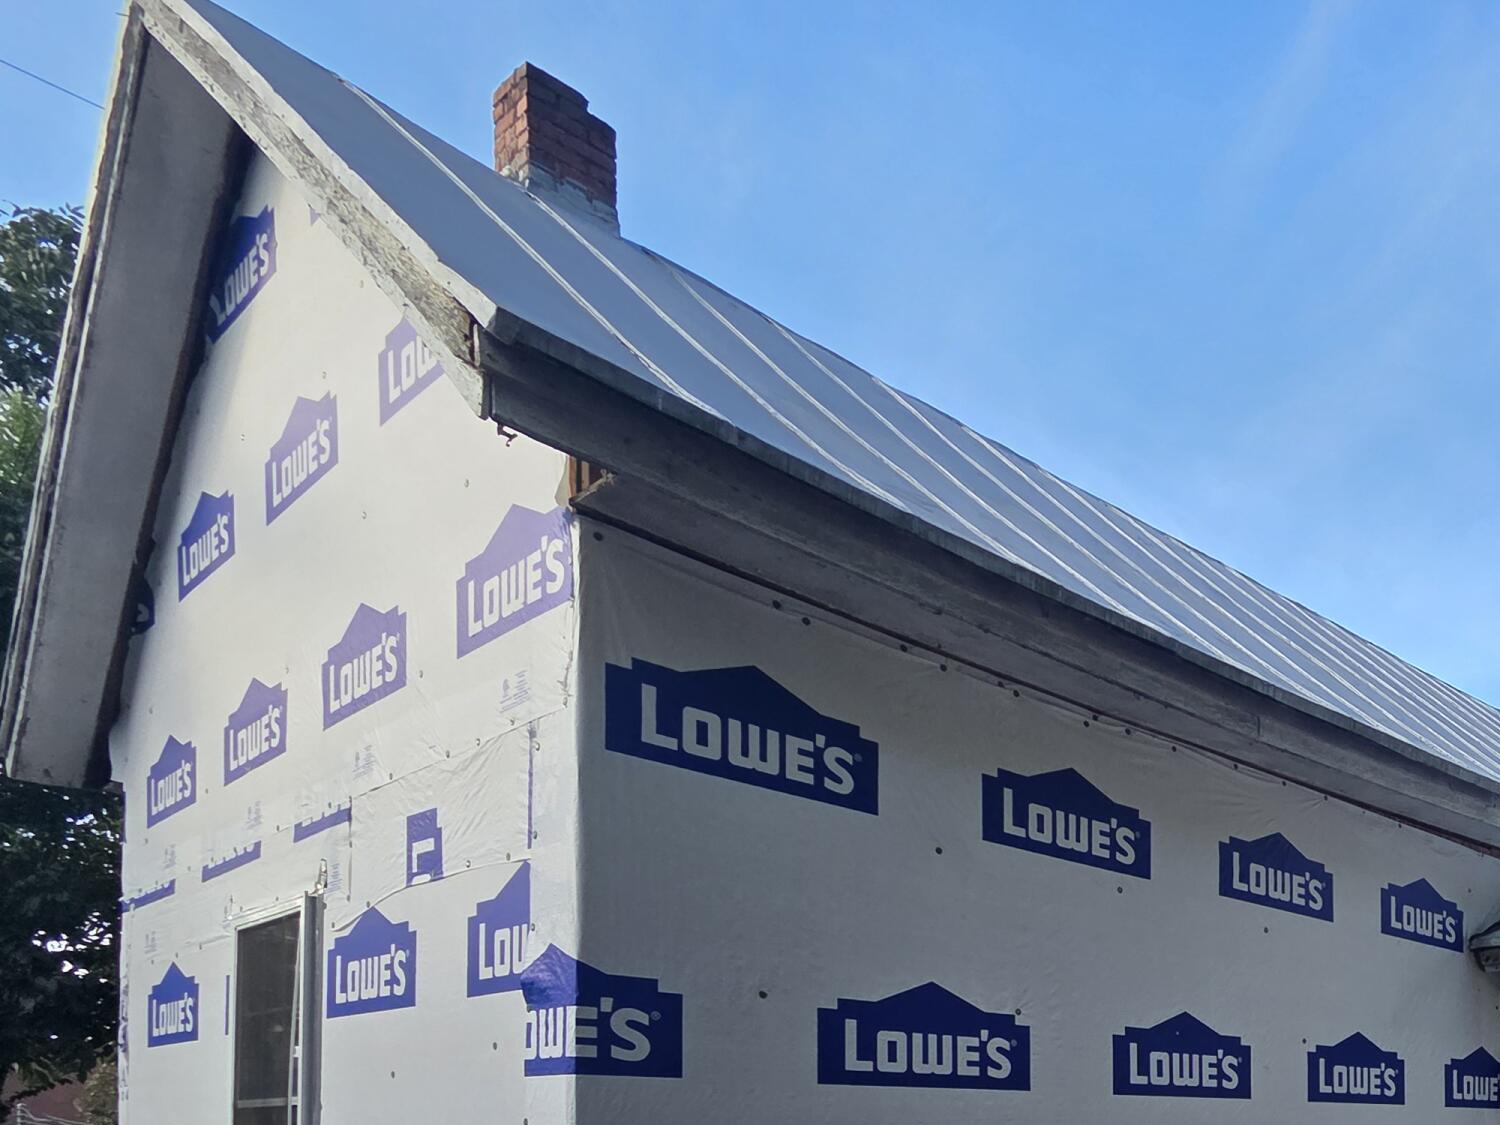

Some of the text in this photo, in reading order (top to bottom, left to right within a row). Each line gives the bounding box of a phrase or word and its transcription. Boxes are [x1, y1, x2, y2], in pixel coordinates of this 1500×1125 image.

[209, 232, 271, 325] LOWE'S
[270, 417, 331, 503] LOWE'S
[182, 513, 229, 586] LOWE'S
[465, 535, 566, 637] LOWE'S
[329, 632, 398, 724] LOWE'S
[230, 706, 281, 769] LOWE'S
[641, 683, 855, 796] LOWE'S
[151, 760, 191, 815] LOWE'S
[1002, 788, 1136, 865] LOWE'S
[1232, 851, 1323, 911] LOWE'S
[1390, 895, 1456, 943] LOWE'S
[335, 945, 408, 1003] LOWE'S
[152, 993, 195, 1036] LOWE'S
[844, 1018, 1012, 1078] LOWE'S
[1129, 1043, 1239, 1090] LOWE'S
[1319, 1057, 1396, 1097] LOWE'S
